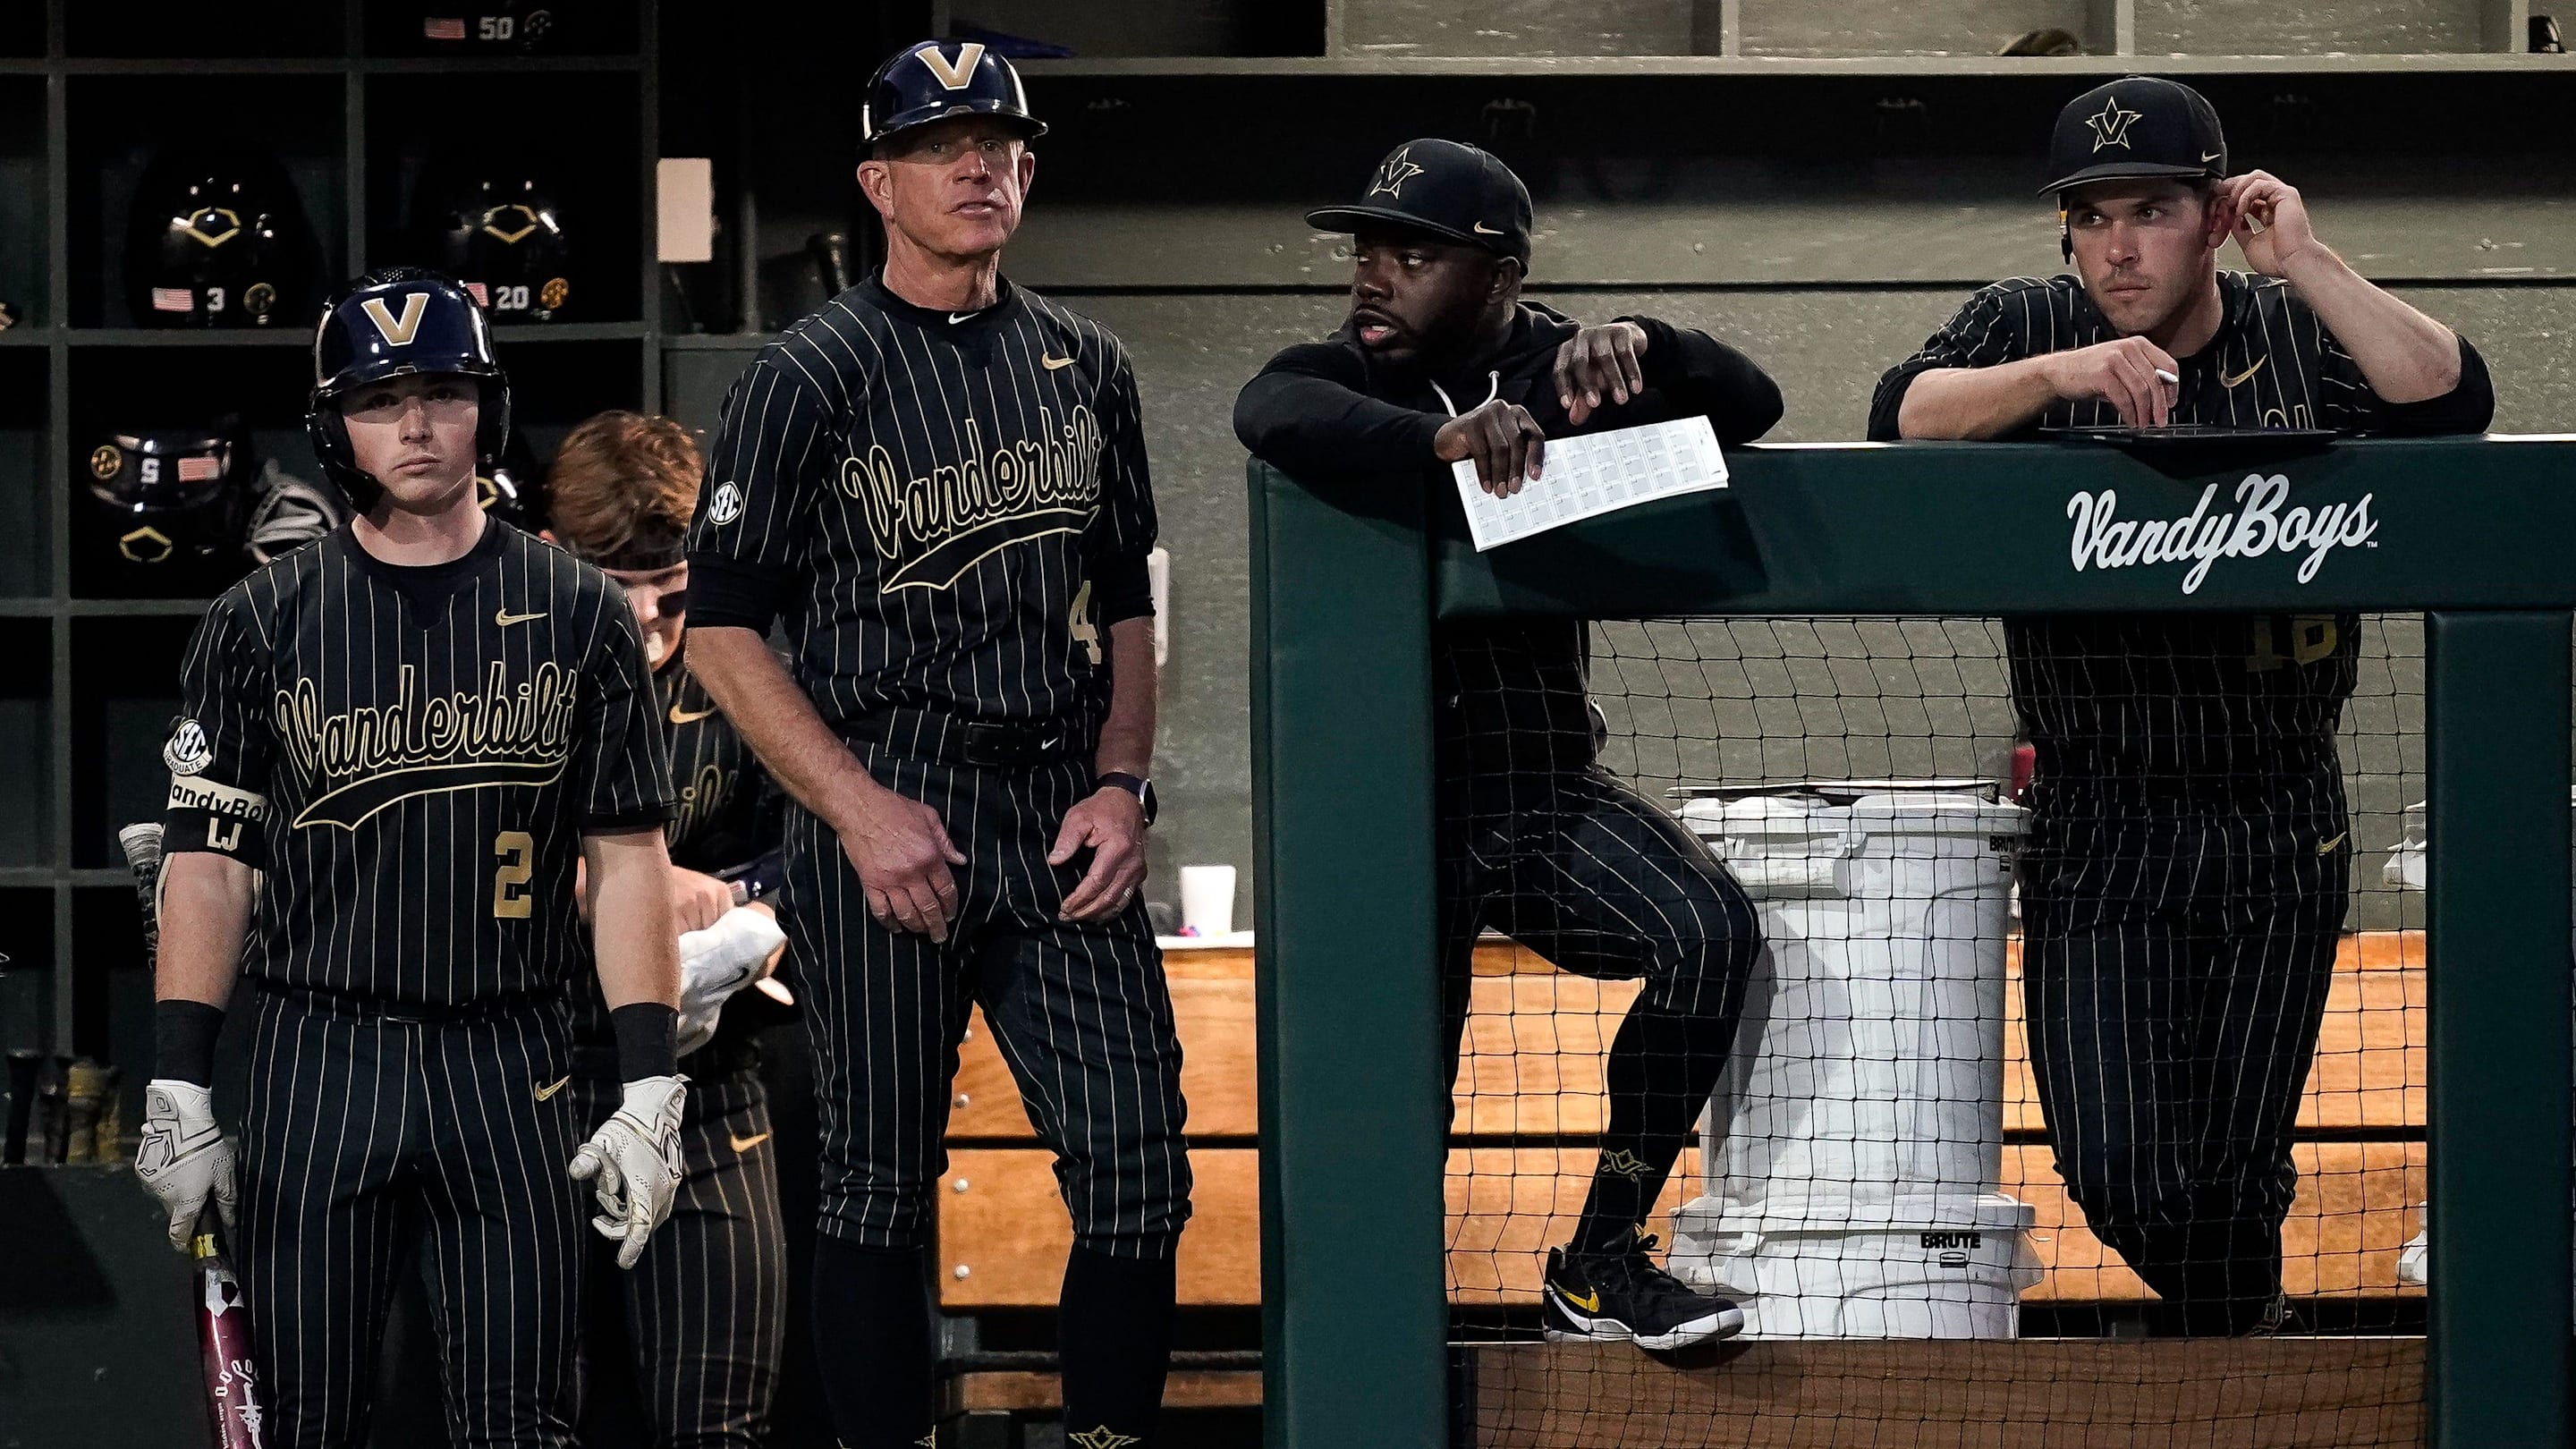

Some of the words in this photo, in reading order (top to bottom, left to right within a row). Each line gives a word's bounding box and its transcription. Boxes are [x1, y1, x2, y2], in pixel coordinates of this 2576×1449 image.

[479, 16, 514, 40] 50
[915, 42, 985, 90] V
[207, 287, 225, 311] 3
[496, 285, 530, 309] 20
[360, 292, 430, 347] V
[140, 458, 160, 484] 5
[842, 404, 1101, 559] Vanderbilt
[711, 484, 740, 521] SEC
[2067, 473, 2378, 595] VandyBoys
[1068, 580, 1102, 665] 4
[174, 723, 207, 761] SEC
[275, 661, 577, 788] Vanderbilt
[164, 750, 203, 773] GRADUATE
[170, 777, 266, 821] andyBo
[207, 817, 242, 852] LJ
[494, 831, 533, 919] 2
[1920, 1232, 1981, 1249] BRUTE
